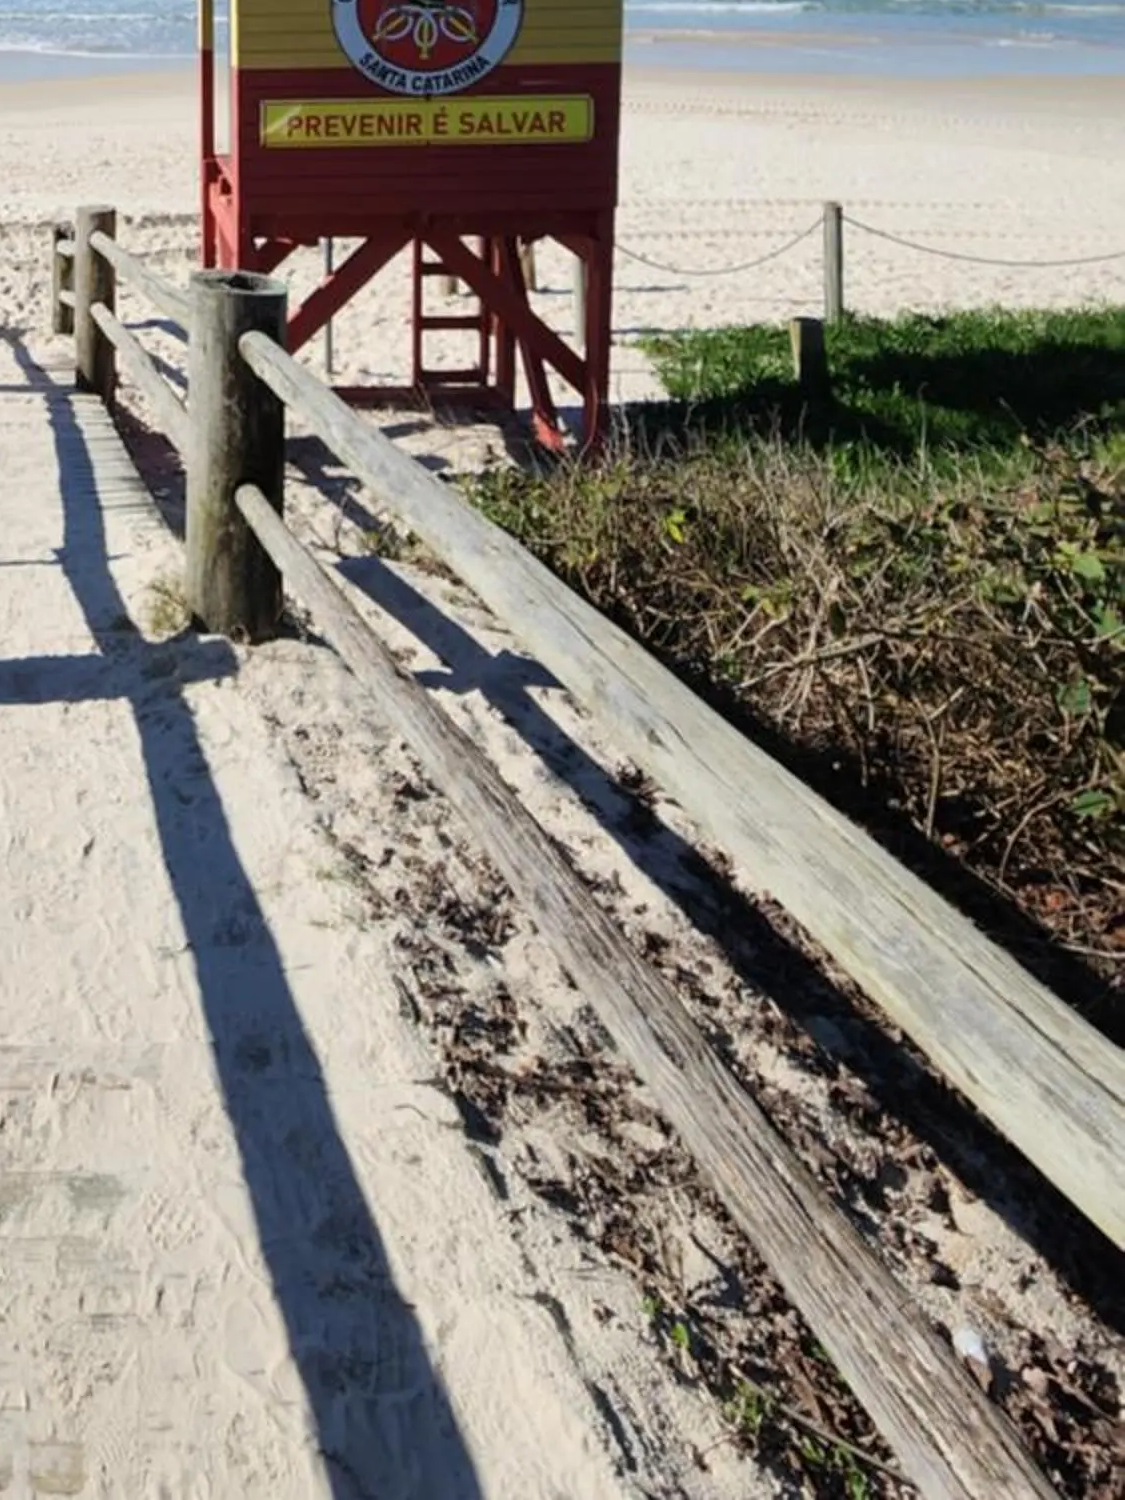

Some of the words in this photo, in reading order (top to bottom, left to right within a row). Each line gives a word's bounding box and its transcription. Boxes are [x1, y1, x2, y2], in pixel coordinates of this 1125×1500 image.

[359, 52, 408, 90] SANTA
[411, 55, 491, 91] CATARINA
[286, 114, 423, 138] PREVENIR
[432, 106, 449, 135] É
[459, 110, 566, 134] SALVAR
